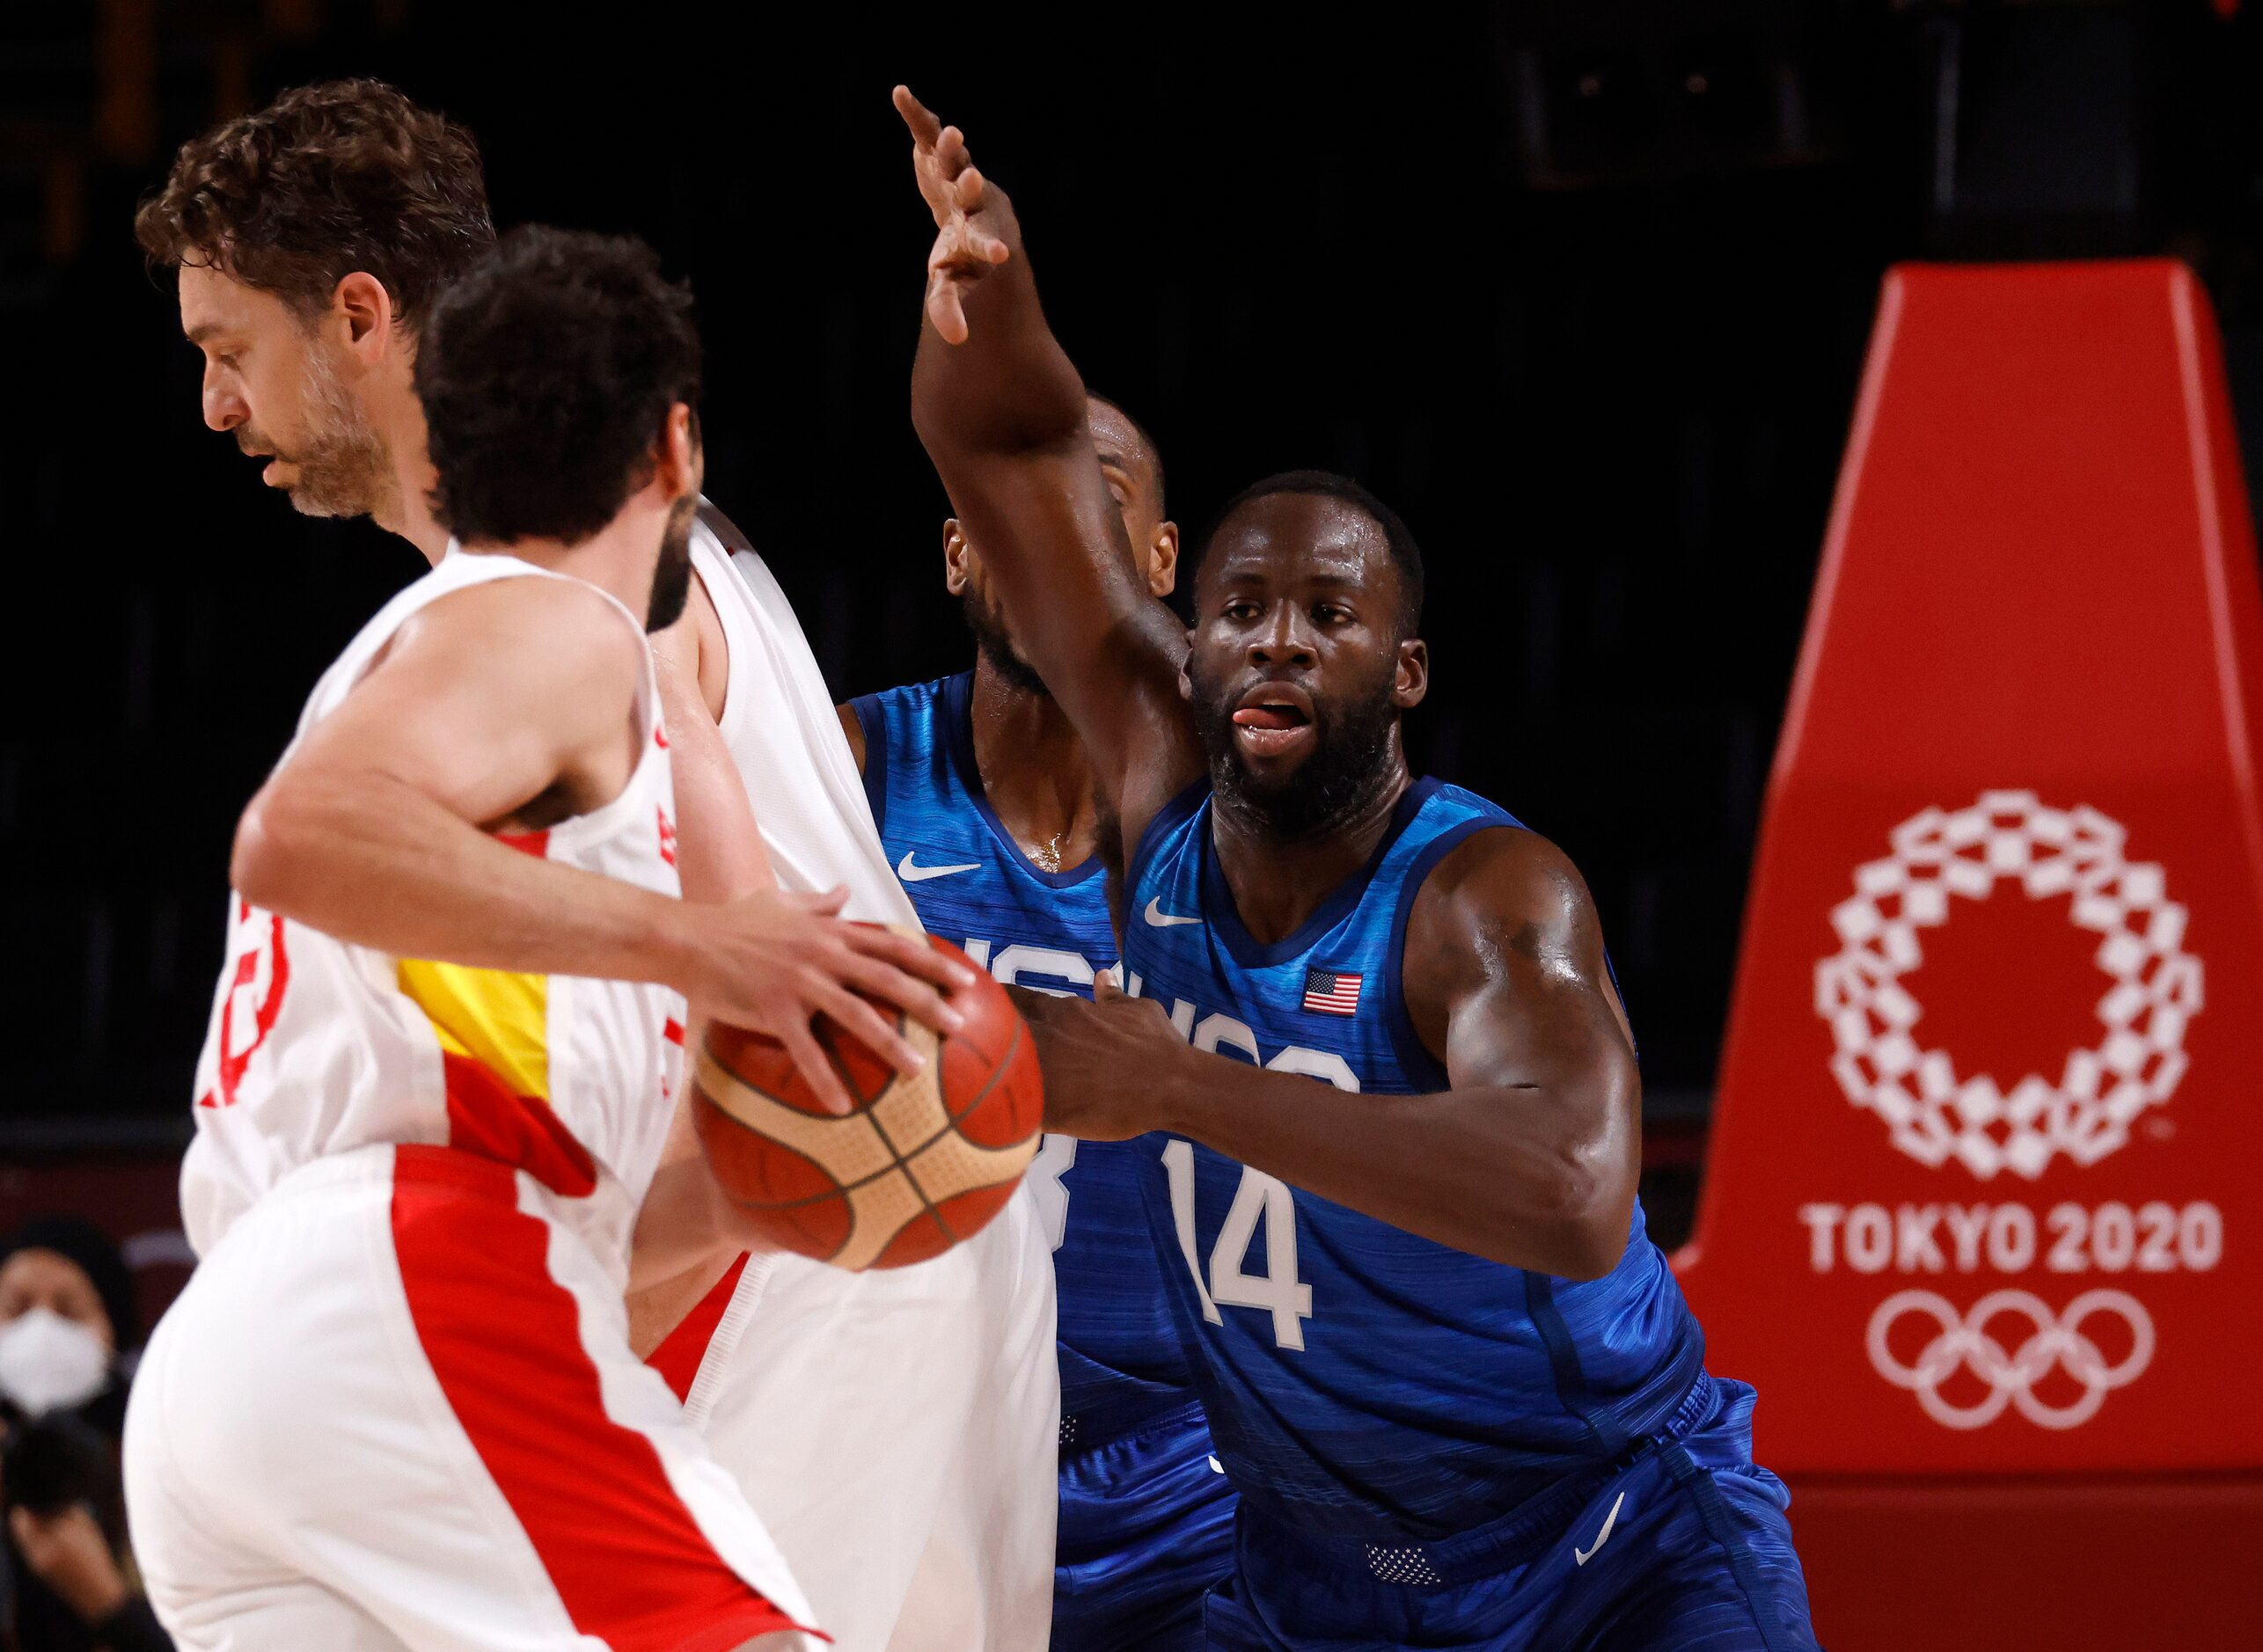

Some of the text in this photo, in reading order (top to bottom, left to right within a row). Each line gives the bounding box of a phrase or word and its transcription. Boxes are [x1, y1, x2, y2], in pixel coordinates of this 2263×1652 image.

[1161, 1138, 1313, 1352] 14
[1800, 1202, 2223, 1273] TOKYO 2020
